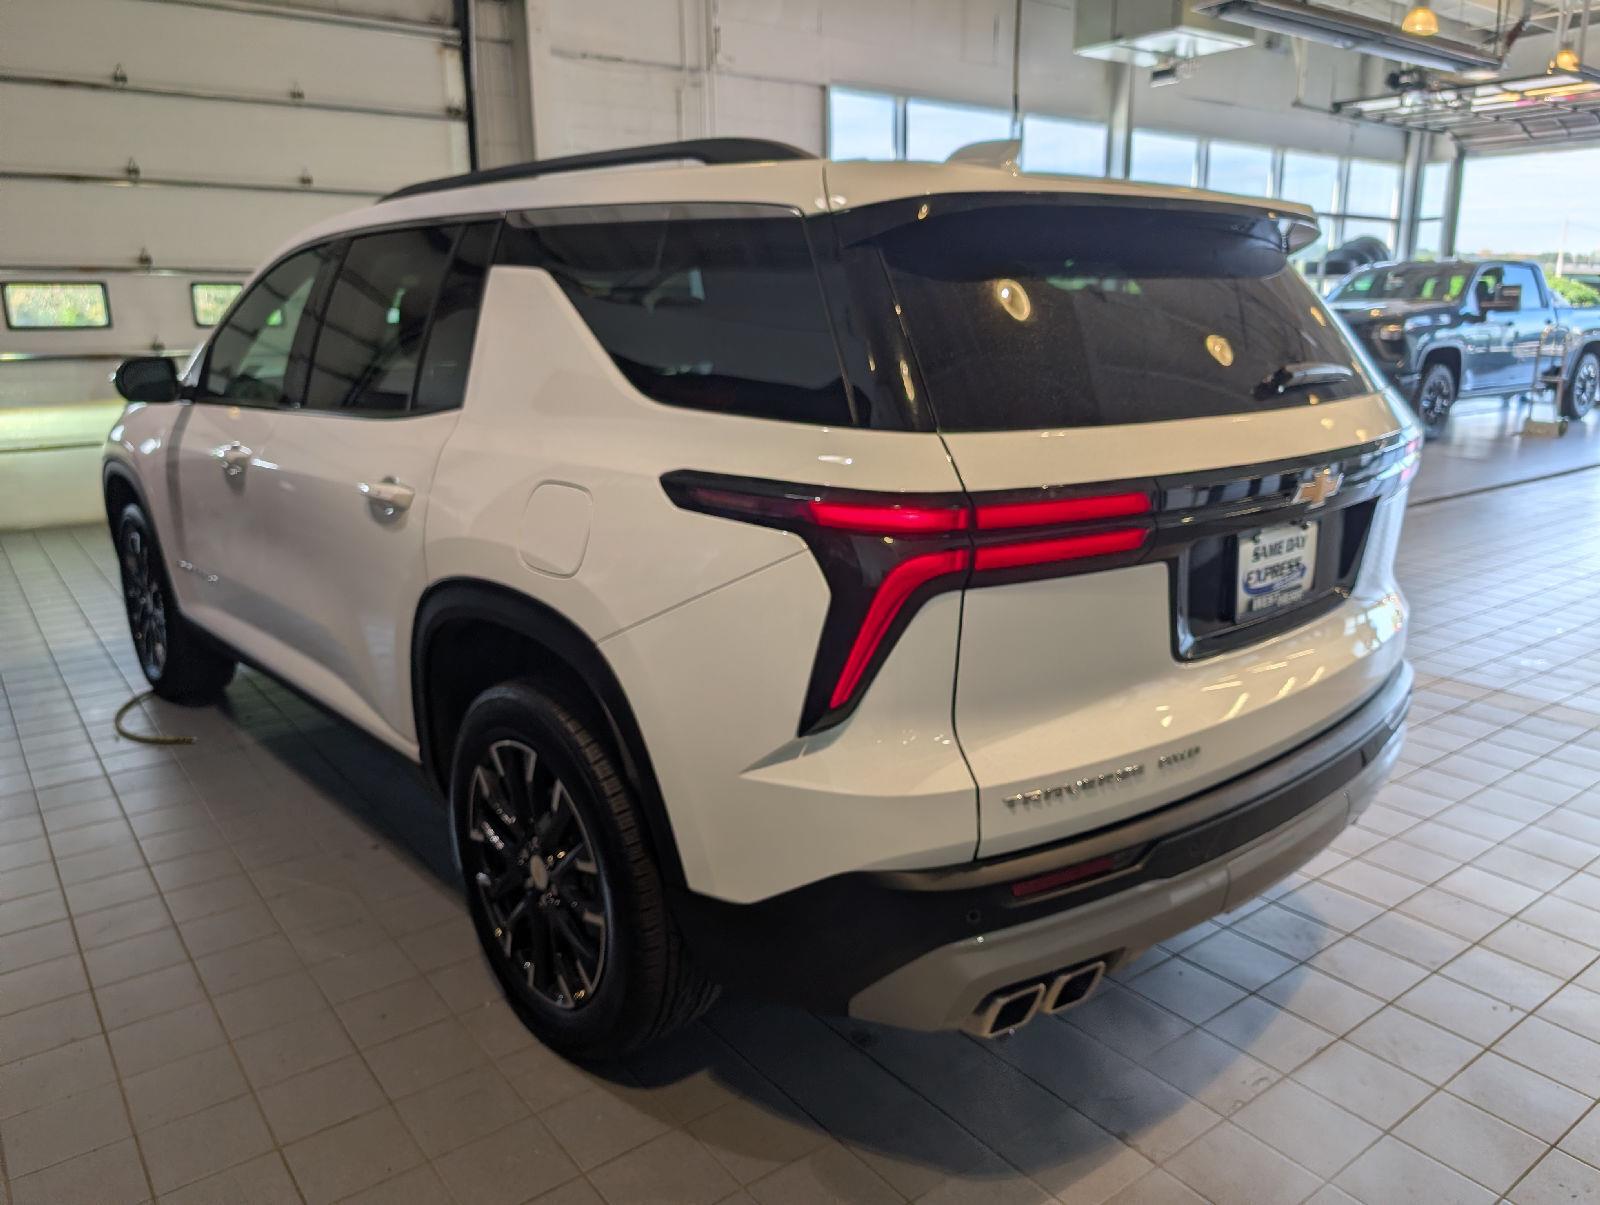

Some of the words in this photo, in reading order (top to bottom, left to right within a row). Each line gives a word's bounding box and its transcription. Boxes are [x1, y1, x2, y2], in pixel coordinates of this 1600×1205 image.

[1251, 541, 1284, 563] SAME
[1286, 535, 1307, 553] DAY
[1247, 557, 1303, 586] EXPRESS
